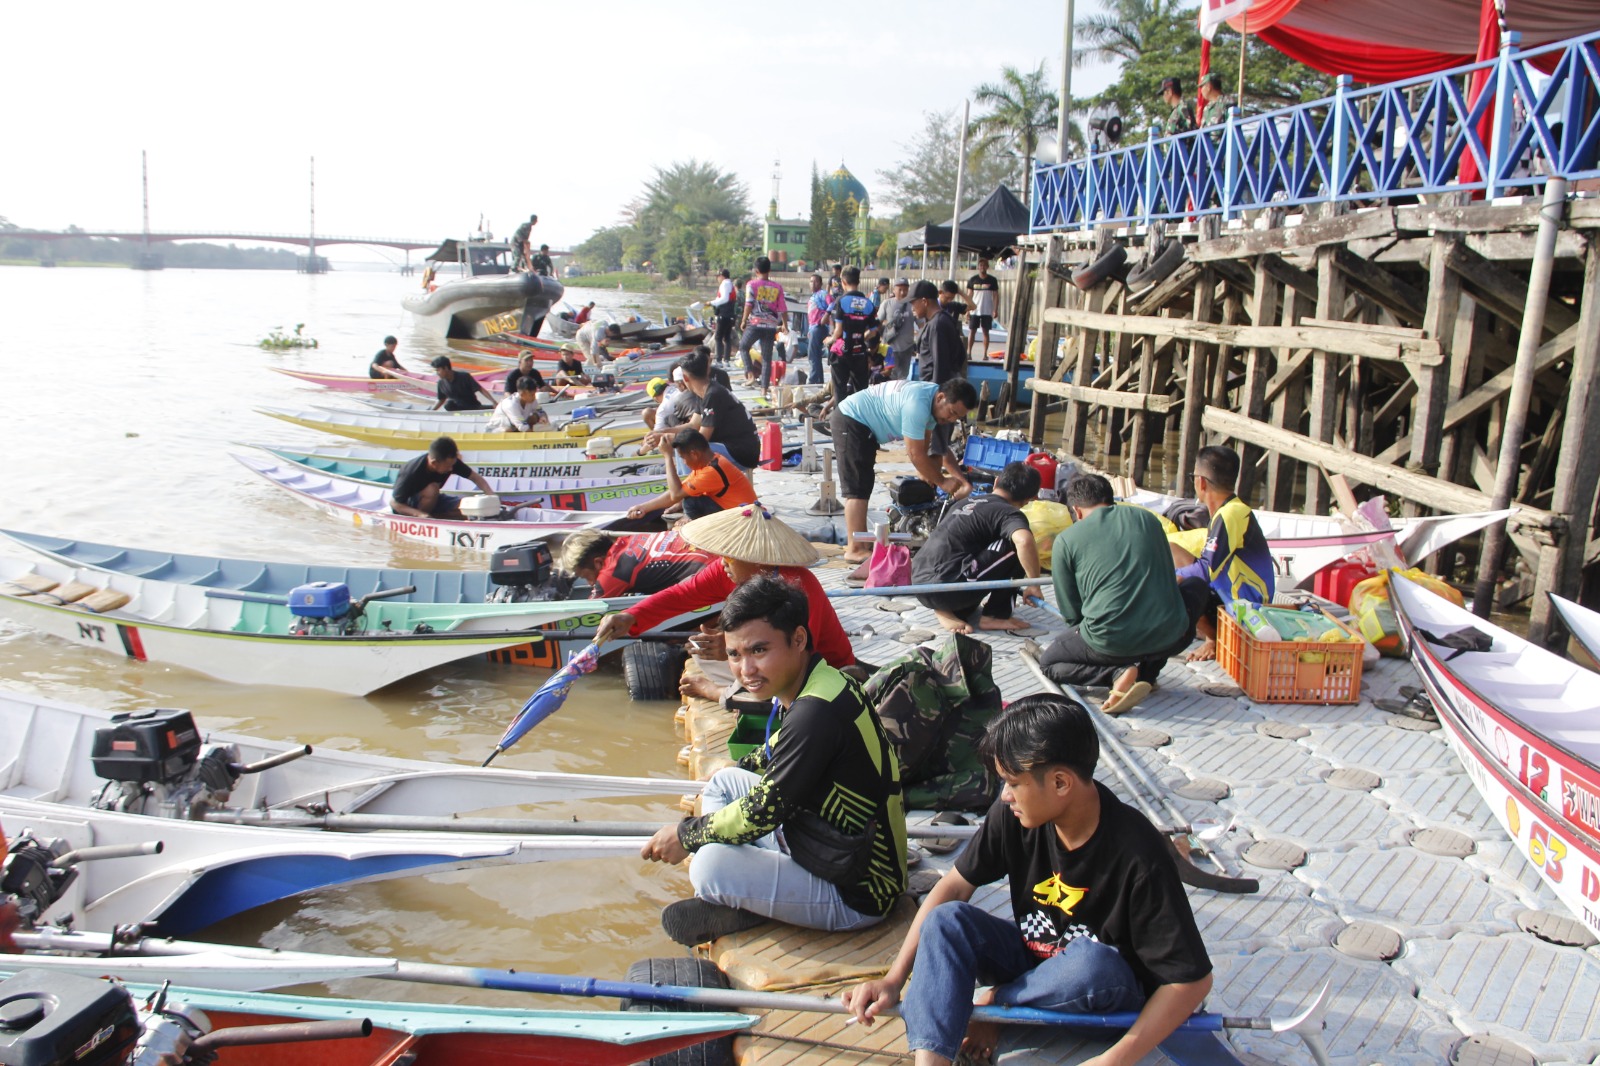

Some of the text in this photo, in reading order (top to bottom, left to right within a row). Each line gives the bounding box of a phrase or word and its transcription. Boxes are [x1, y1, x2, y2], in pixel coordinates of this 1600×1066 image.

[478, 465, 582, 478] BERKAT HIKMAH
[589, 484, 670, 503] pemde
[390, 521, 439, 538] DUCATI
[77, 621, 105, 643] NT
[1518, 744, 1550, 798] 12
[1529, 821, 1567, 883] 63
